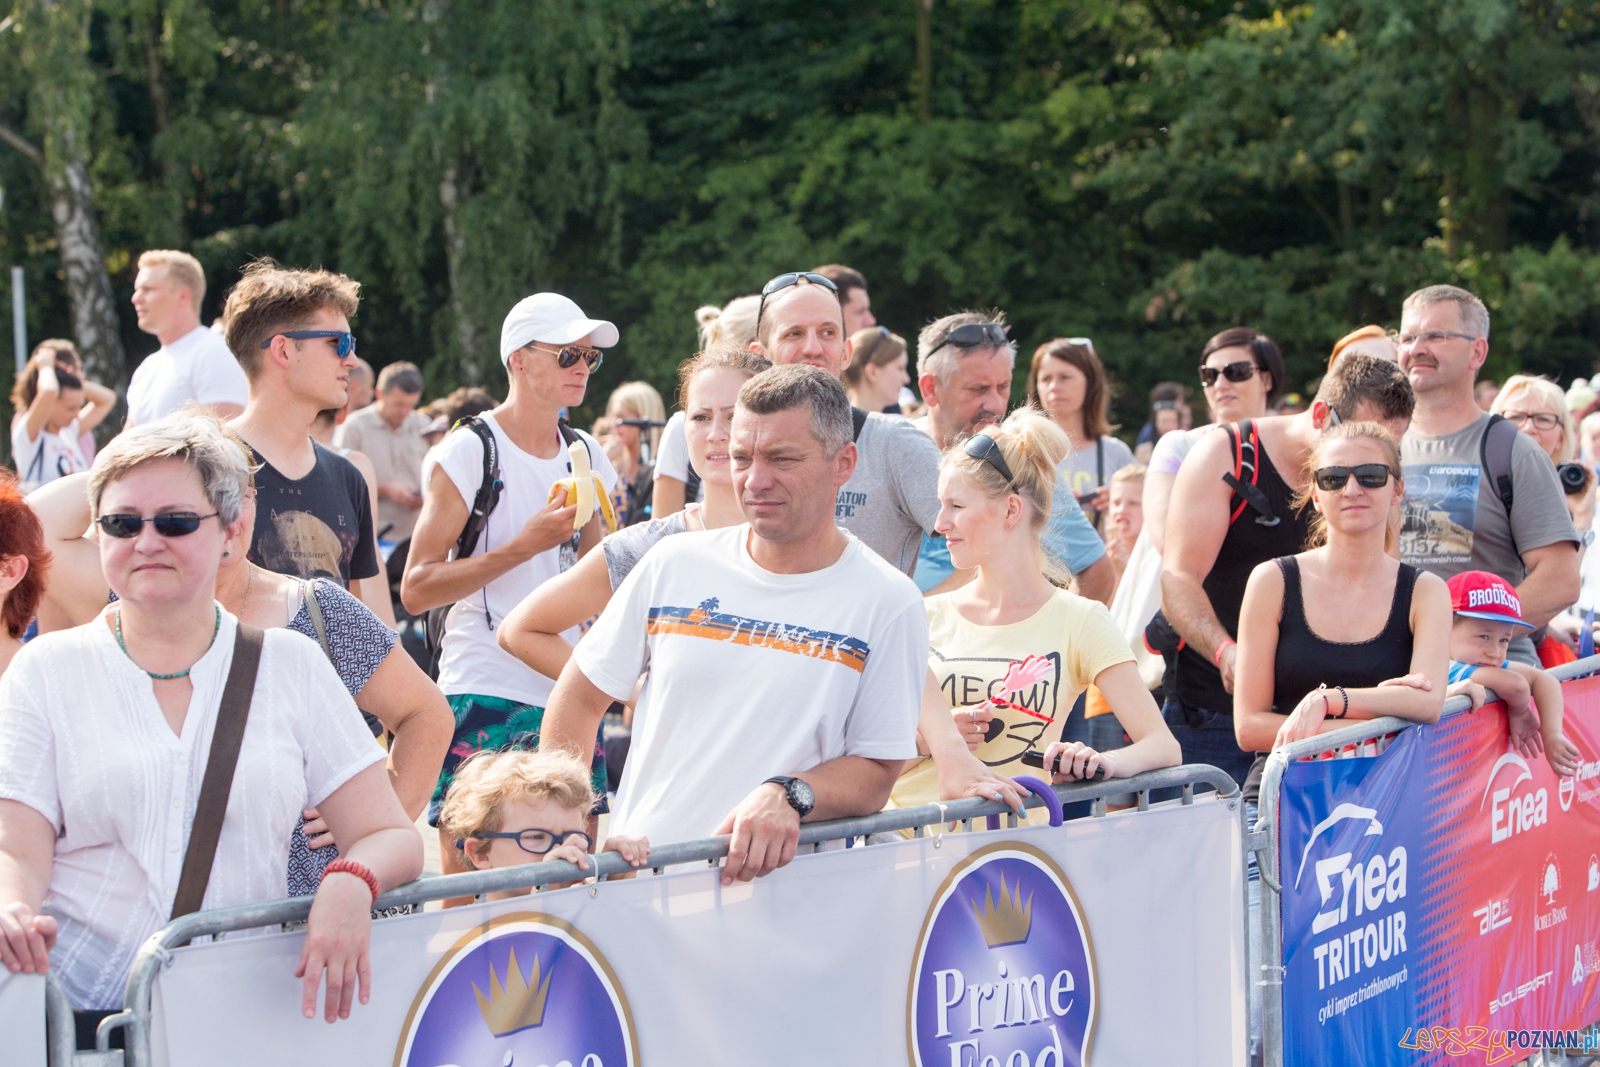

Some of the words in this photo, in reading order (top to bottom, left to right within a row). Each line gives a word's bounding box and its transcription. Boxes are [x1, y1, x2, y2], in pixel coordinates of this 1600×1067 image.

[836, 491, 867, 506] ATOR
[1429, 465, 1479, 476] Barcelona
[834, 505, 855, 517] IFIC
[1469, 589, 1522, 617] BROOKLYN
[1491, 788, 1548, 844] Enea
[1312, 846, 1407, 934] Enea
[1313, 910, 1408, 990] TRITOUR
[933, 960, 1075, 1039] Prime
[1318, 998, 1334, 1026] cykl
[1335, 991, 1358, 1016] imprez
[1358, 963, 1408, 1003] triathlonowych
